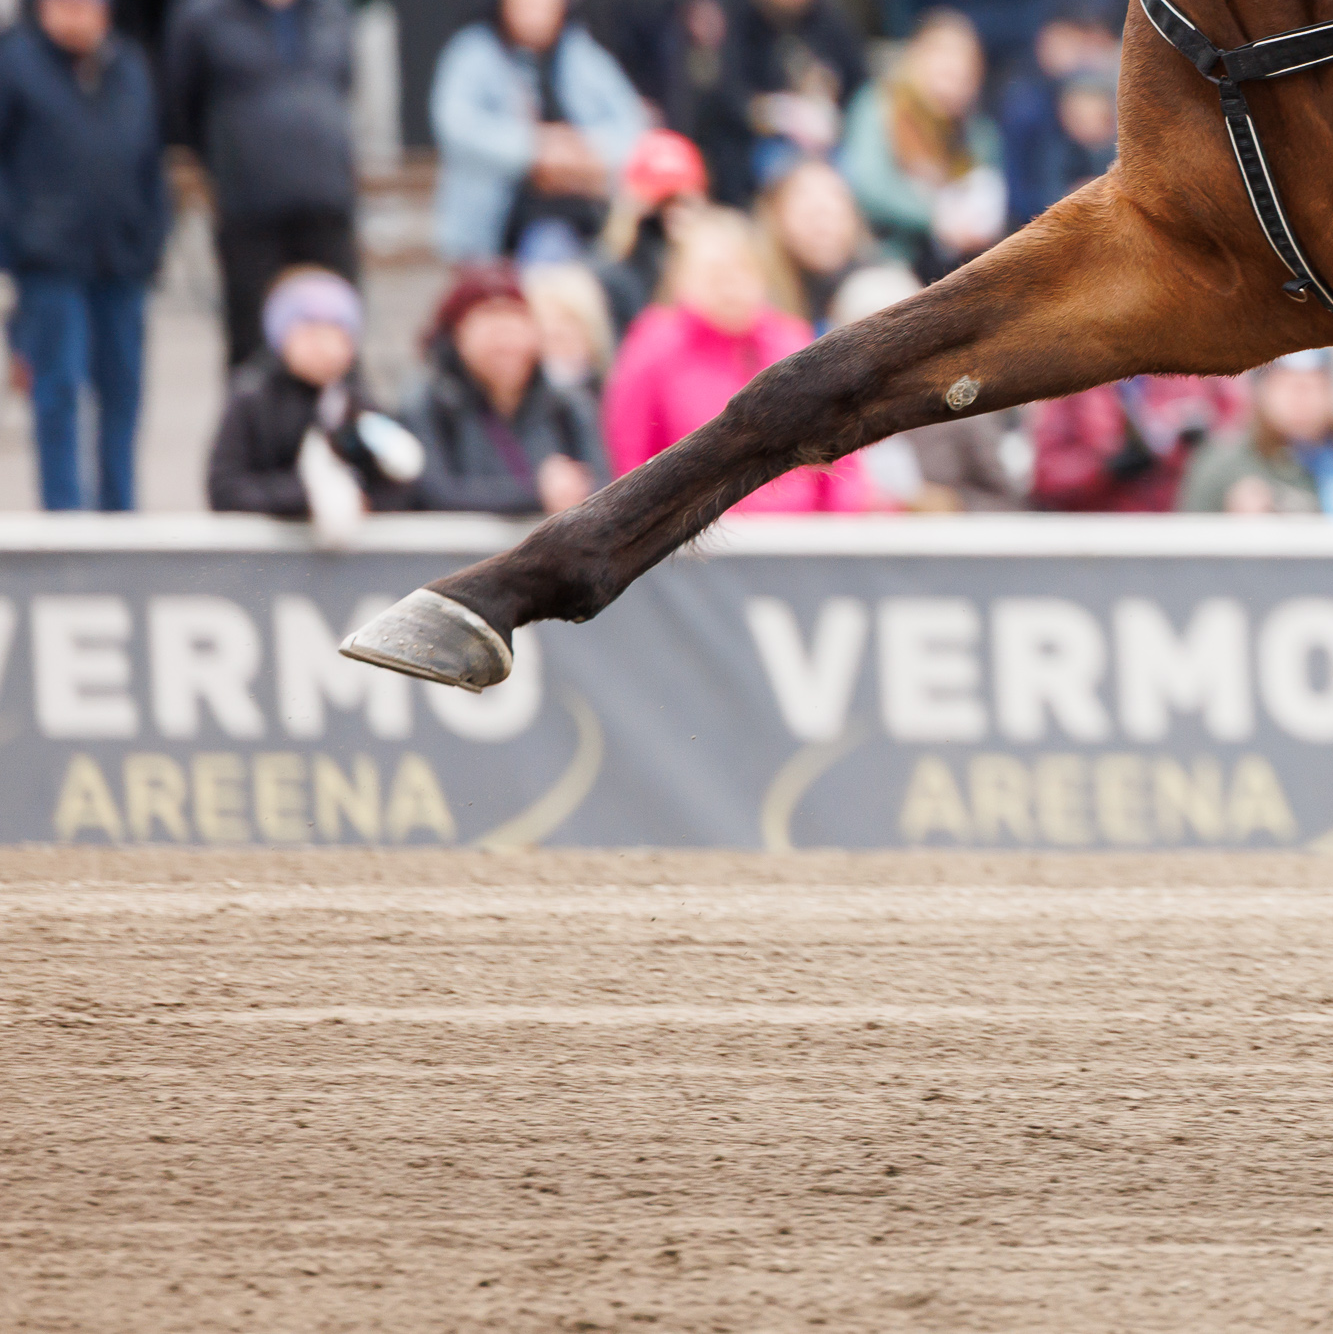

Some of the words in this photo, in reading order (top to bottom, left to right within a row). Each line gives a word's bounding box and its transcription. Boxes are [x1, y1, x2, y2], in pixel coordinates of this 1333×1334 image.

[0, 593, 547, 743] ERMO
[52, 751, 458, 845] AREENA
[898, 752, 1298, 846] AREENA
